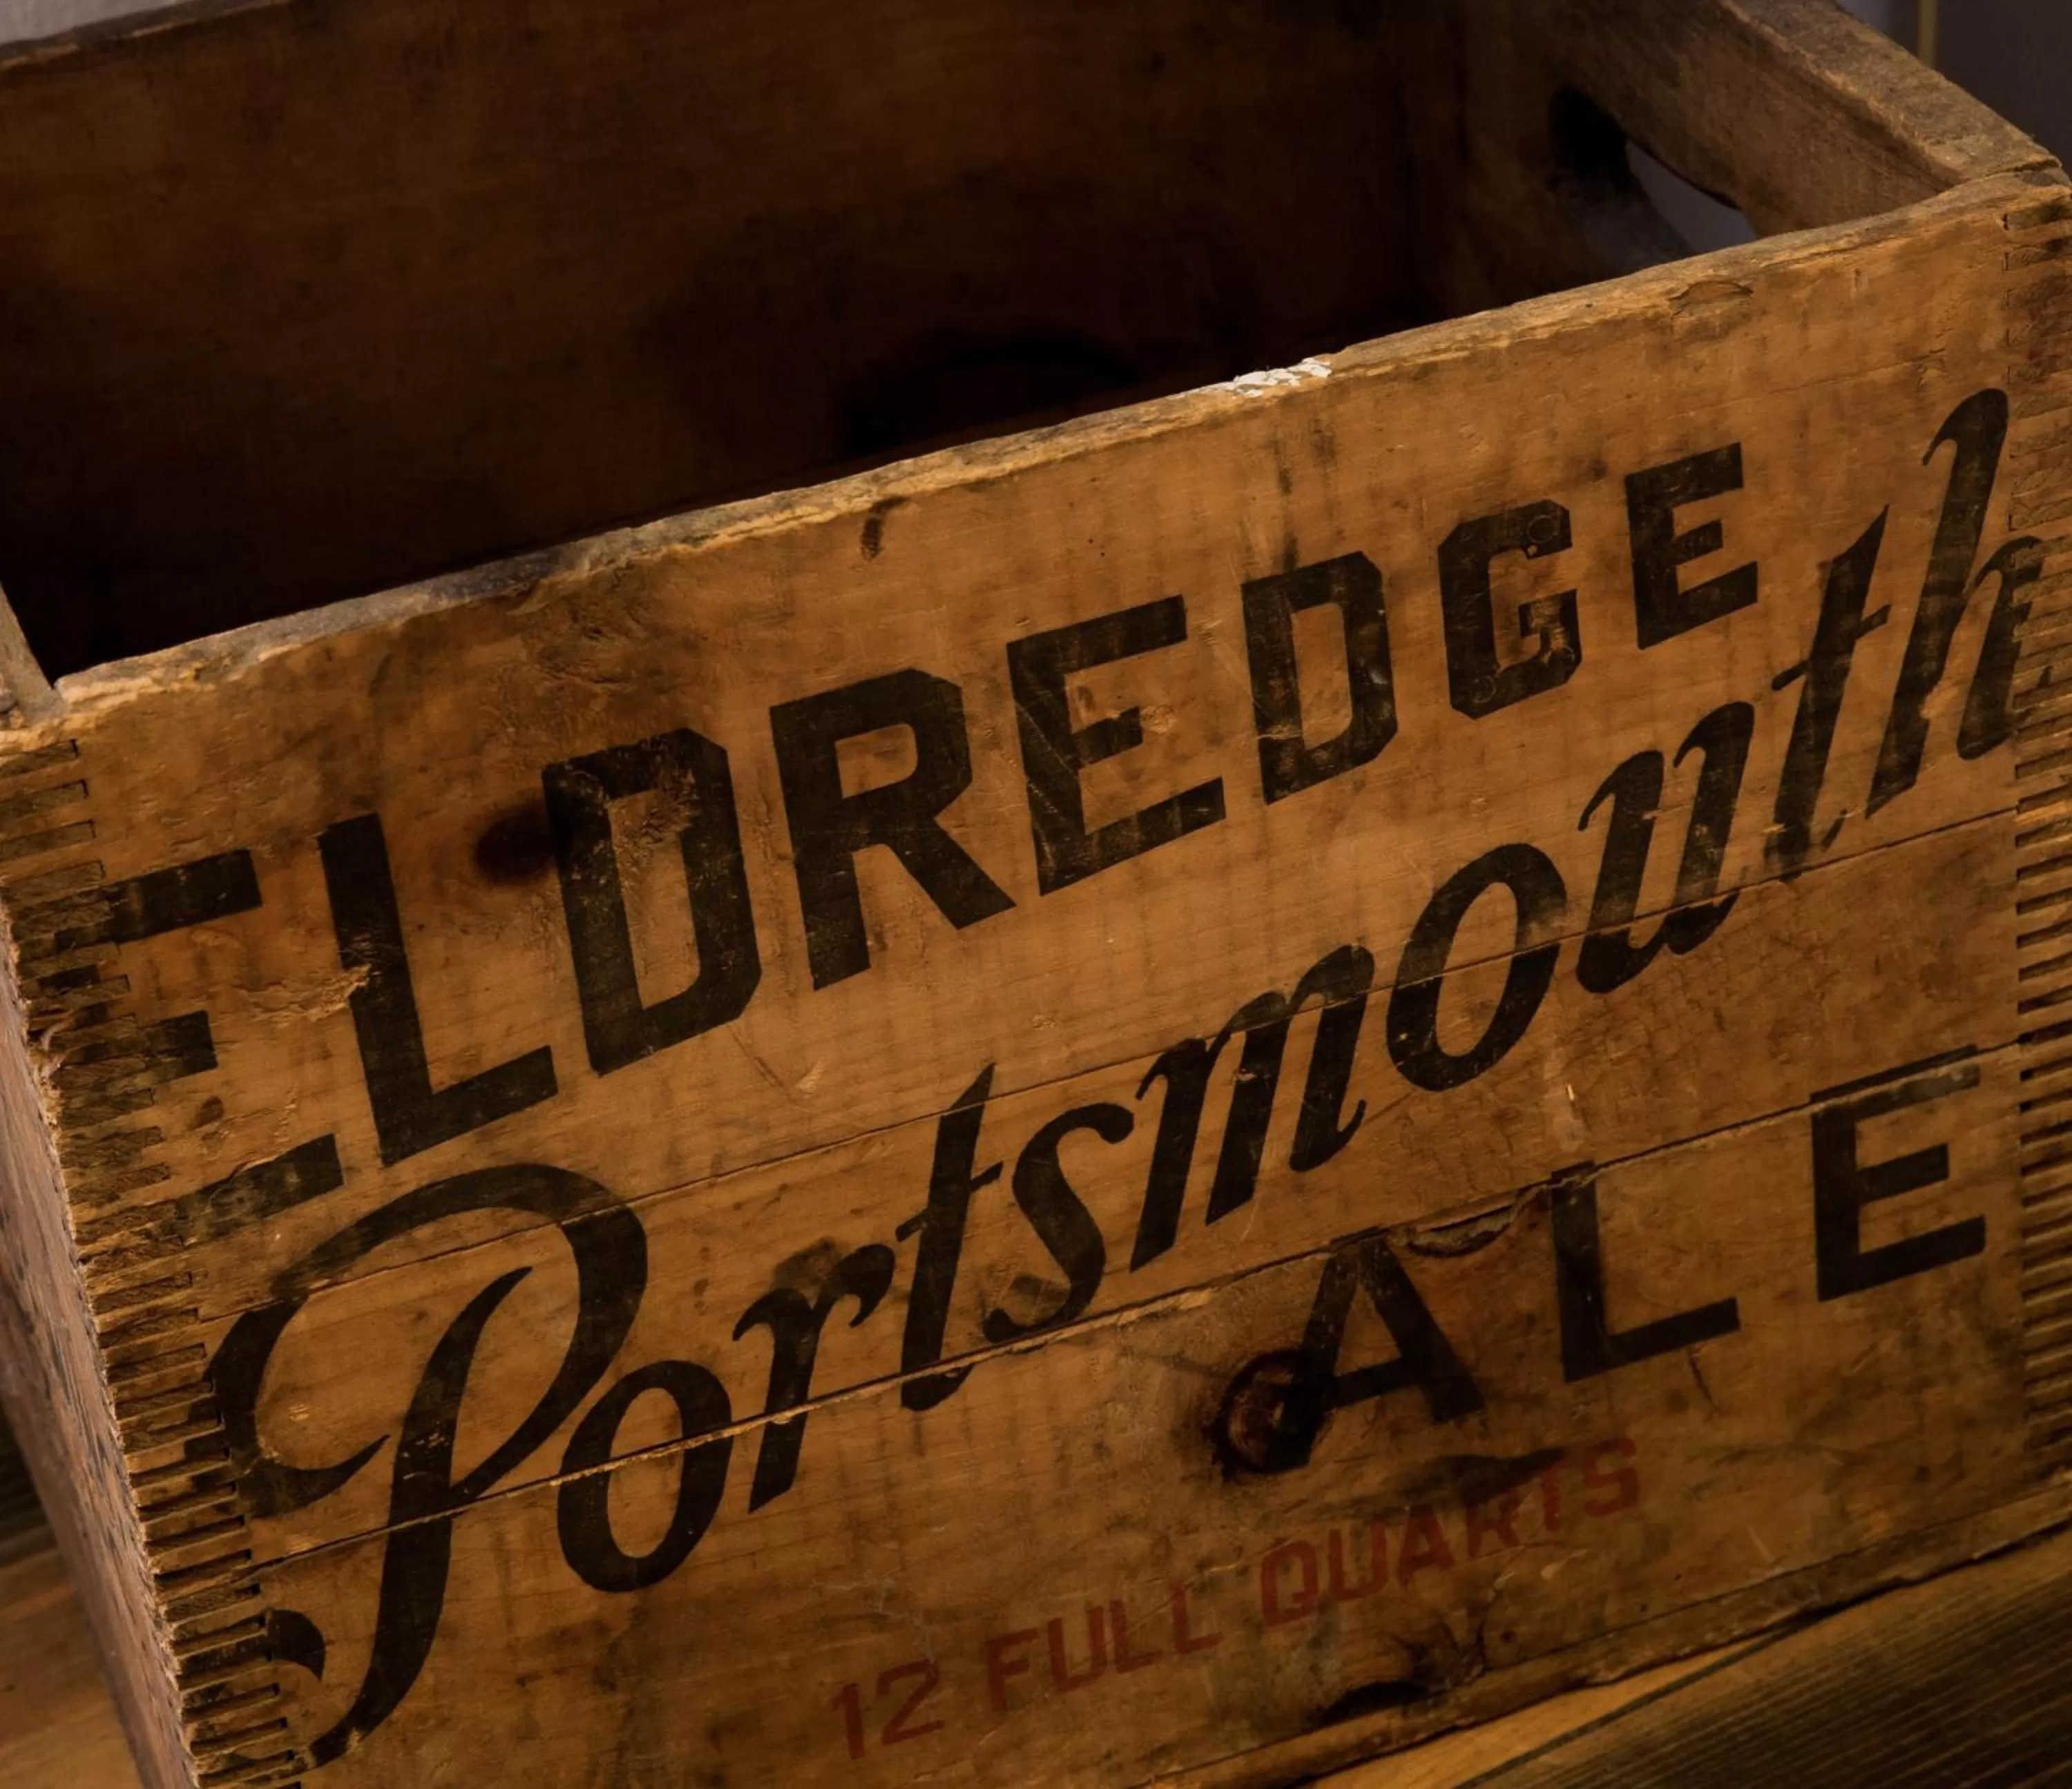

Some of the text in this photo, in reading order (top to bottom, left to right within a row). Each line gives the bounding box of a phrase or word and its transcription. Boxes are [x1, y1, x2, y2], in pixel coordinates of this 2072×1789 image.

[17, 442, 1758, 1247] ELDREDGE
[180, 388, 2046, 1767] Portsmouth
[1268, 1044, 1986, 1474] ALE
[833, 1435, 1641, 1760] 12 FULL QUARTS
